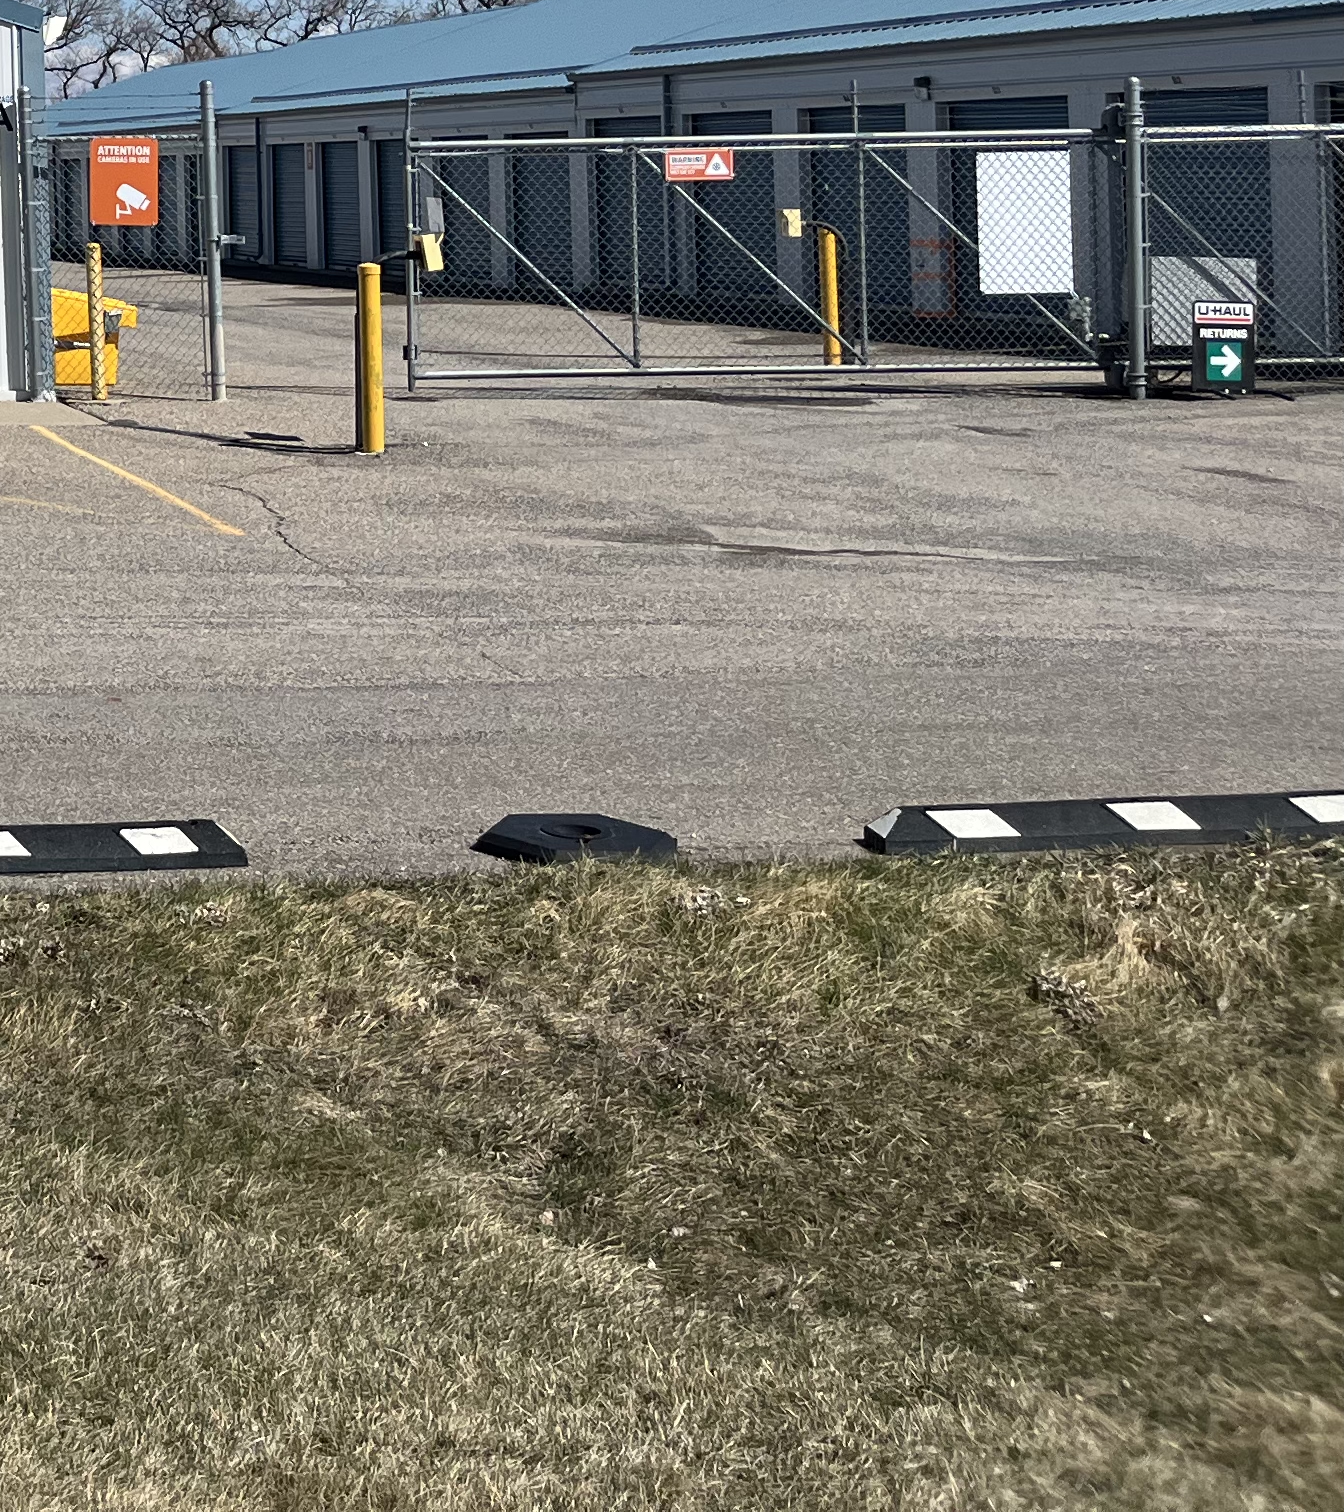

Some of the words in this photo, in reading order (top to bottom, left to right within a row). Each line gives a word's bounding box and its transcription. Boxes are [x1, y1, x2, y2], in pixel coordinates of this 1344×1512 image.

[97, 145, 151, 156] ATTENTION
[97, 155, 128, 164] CAMERAS
[1197, 305, 1251, 317] U-HAUL
[1199, 327, 1248, 339] RETURNS
